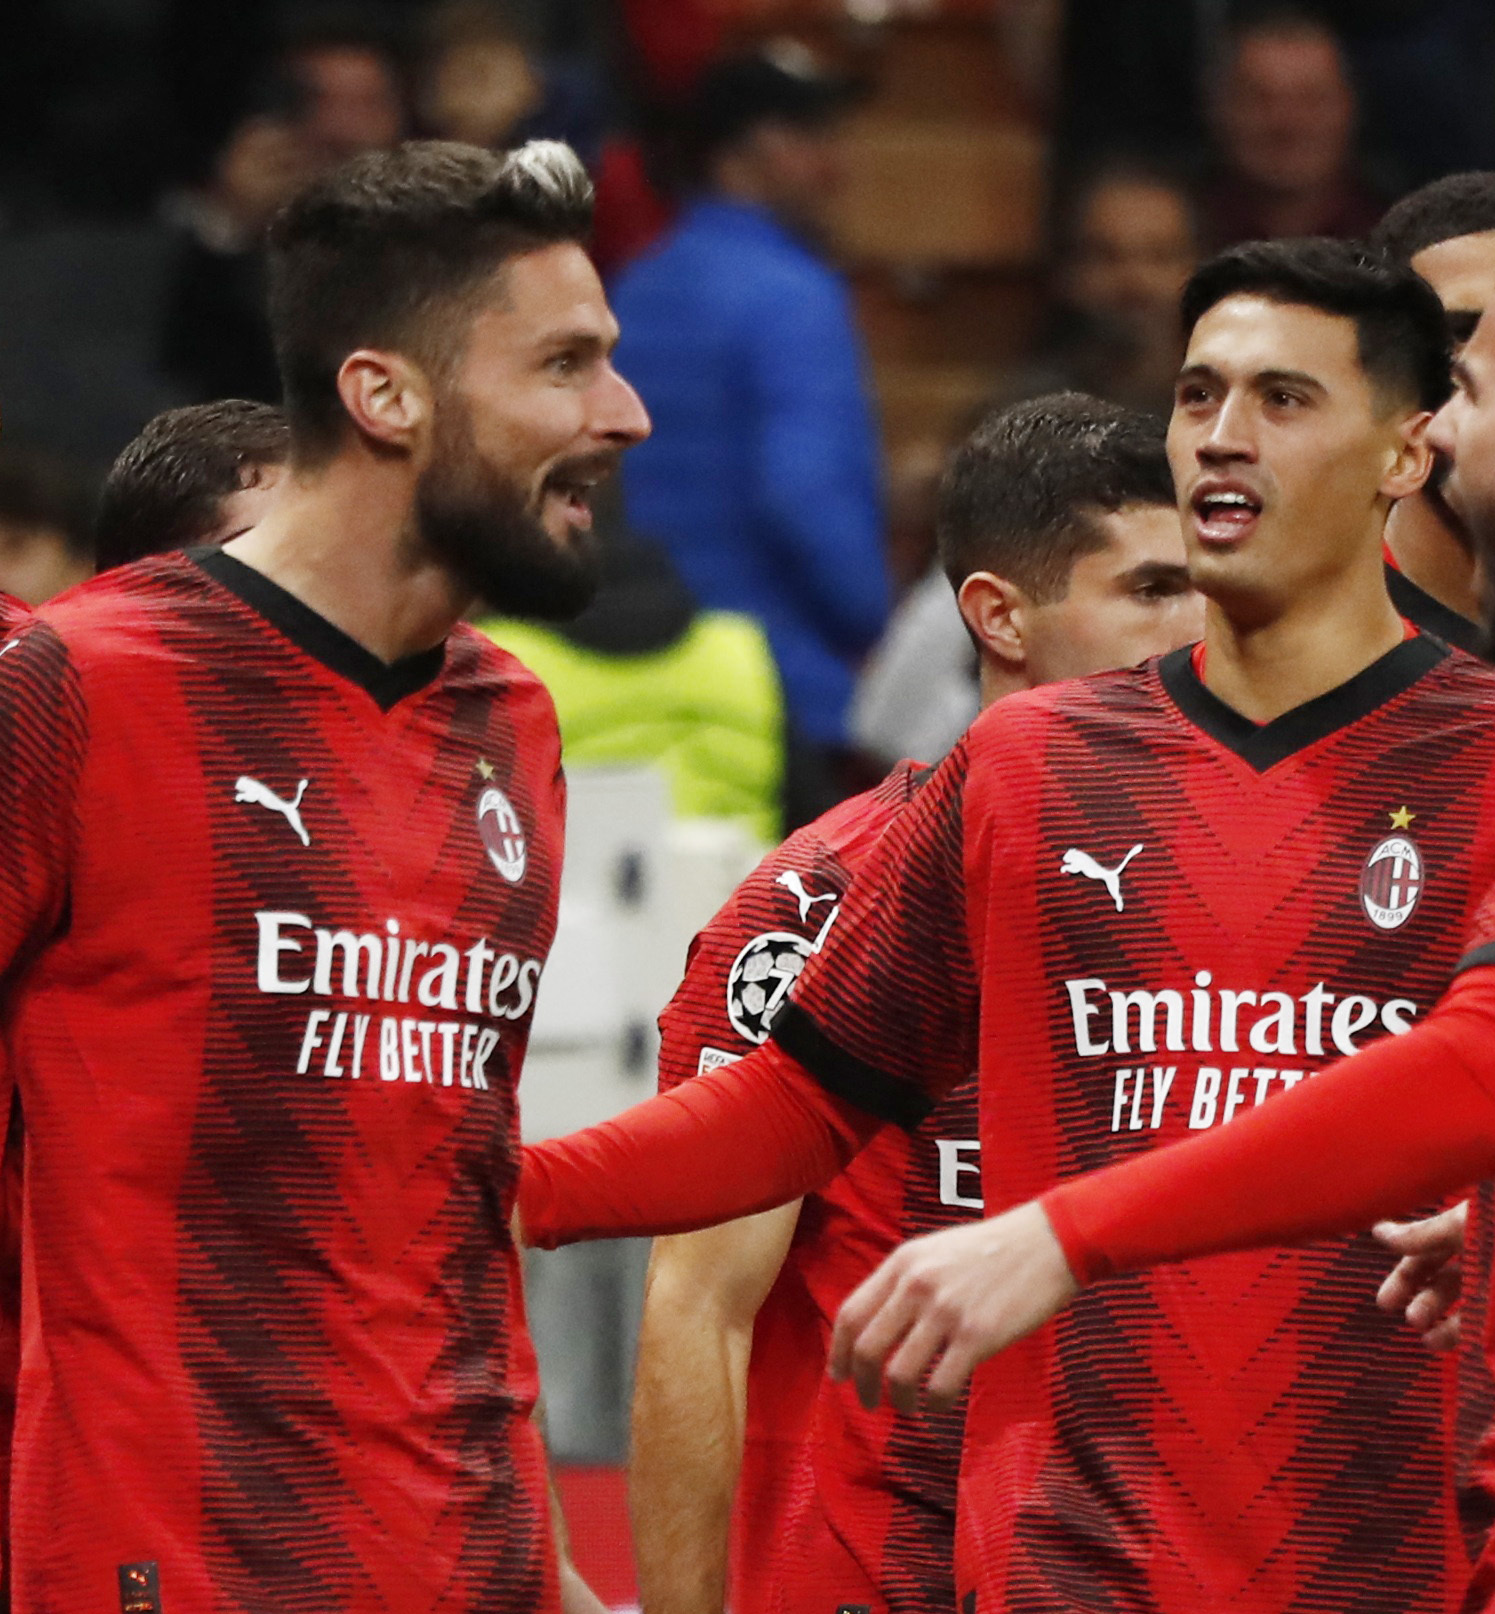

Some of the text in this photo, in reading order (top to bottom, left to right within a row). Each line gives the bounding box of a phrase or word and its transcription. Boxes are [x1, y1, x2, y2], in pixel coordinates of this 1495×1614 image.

[255, 911, 541, 1021] Emirates
[296, 1009, 500, 1091] FLY BETTER
[1065, 970, 1417, 1057] Emirates
[1111, 1066, 1320, 1132] FLY BETT
